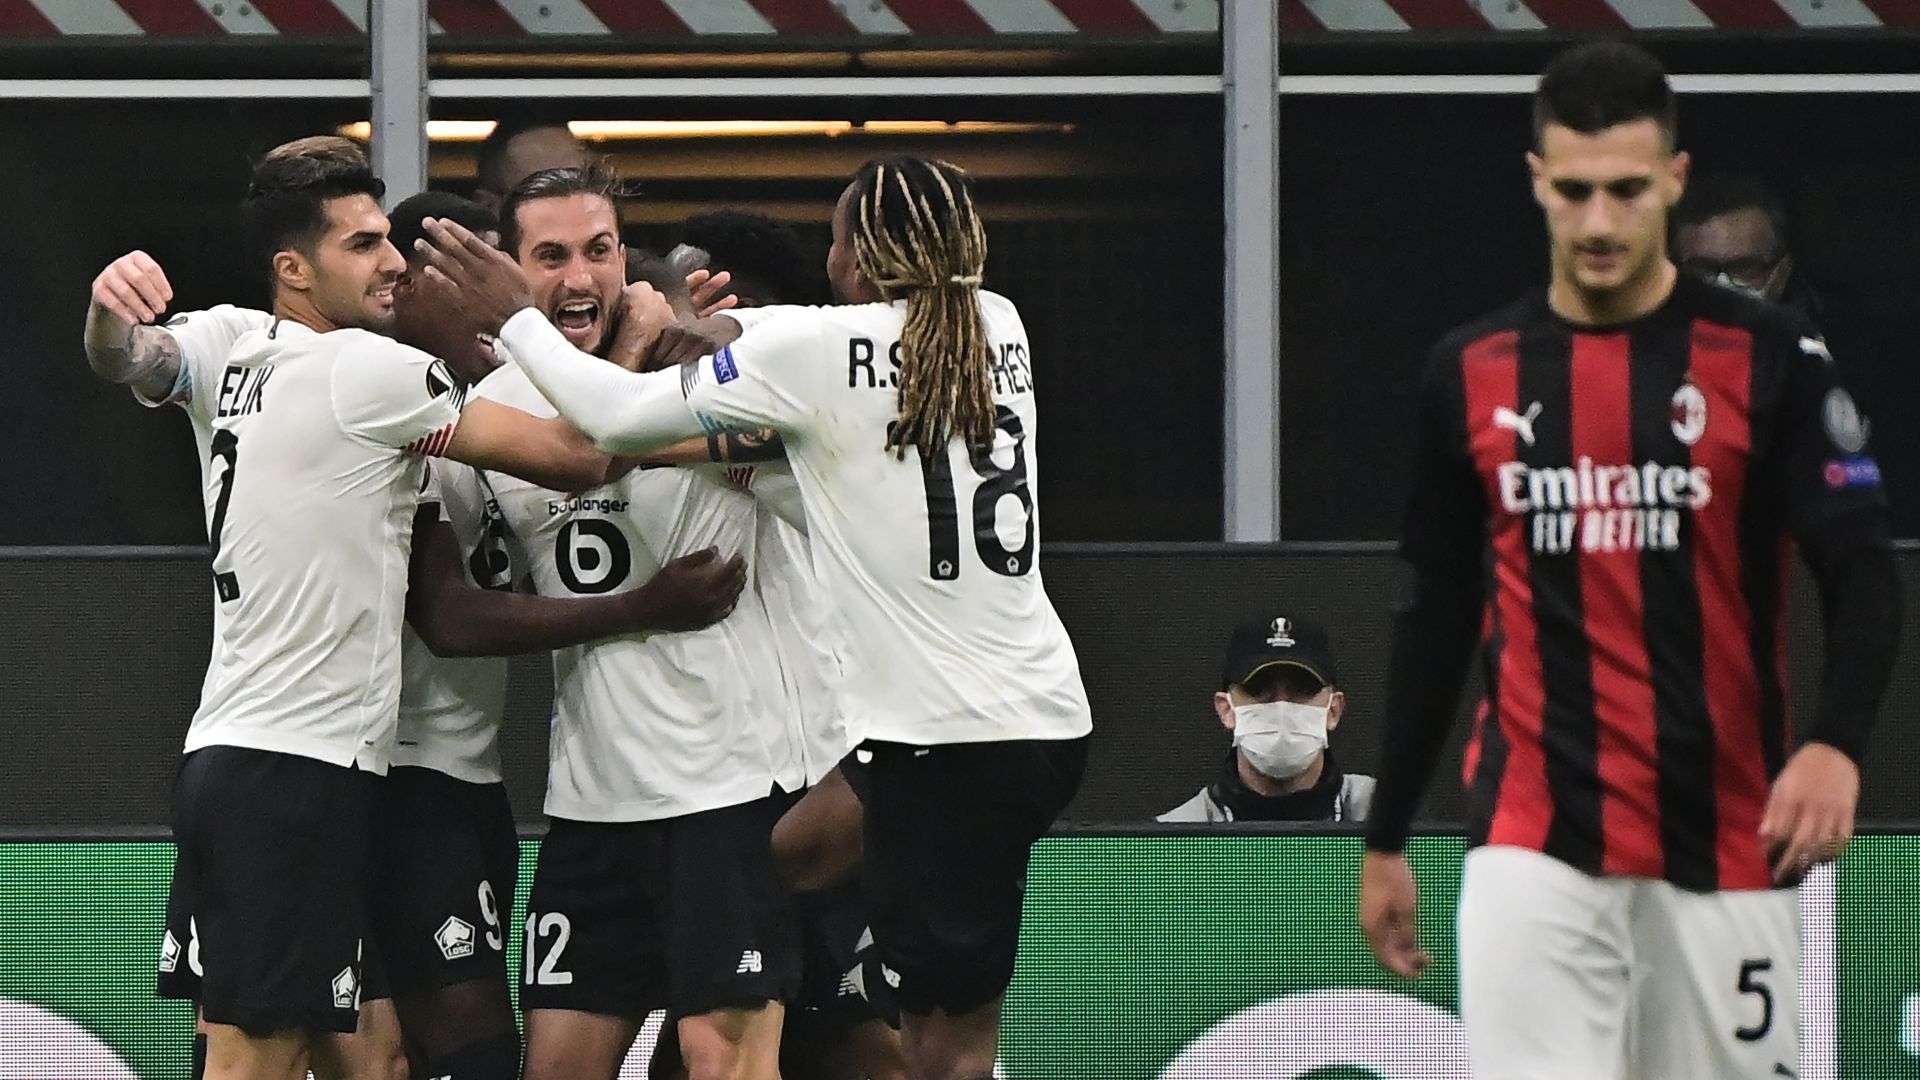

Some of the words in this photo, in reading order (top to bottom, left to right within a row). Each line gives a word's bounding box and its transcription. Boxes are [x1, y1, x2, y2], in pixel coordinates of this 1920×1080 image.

[549, 497, 630, 515] boulanger
[886, 404, 1036, 581] 18
[1497, 455, 1712, 514] Emirates
[478, 880, 502, 950] 9
[525, 912, 573, 985] 12
[1735, 957, 1774, 1042] 5
